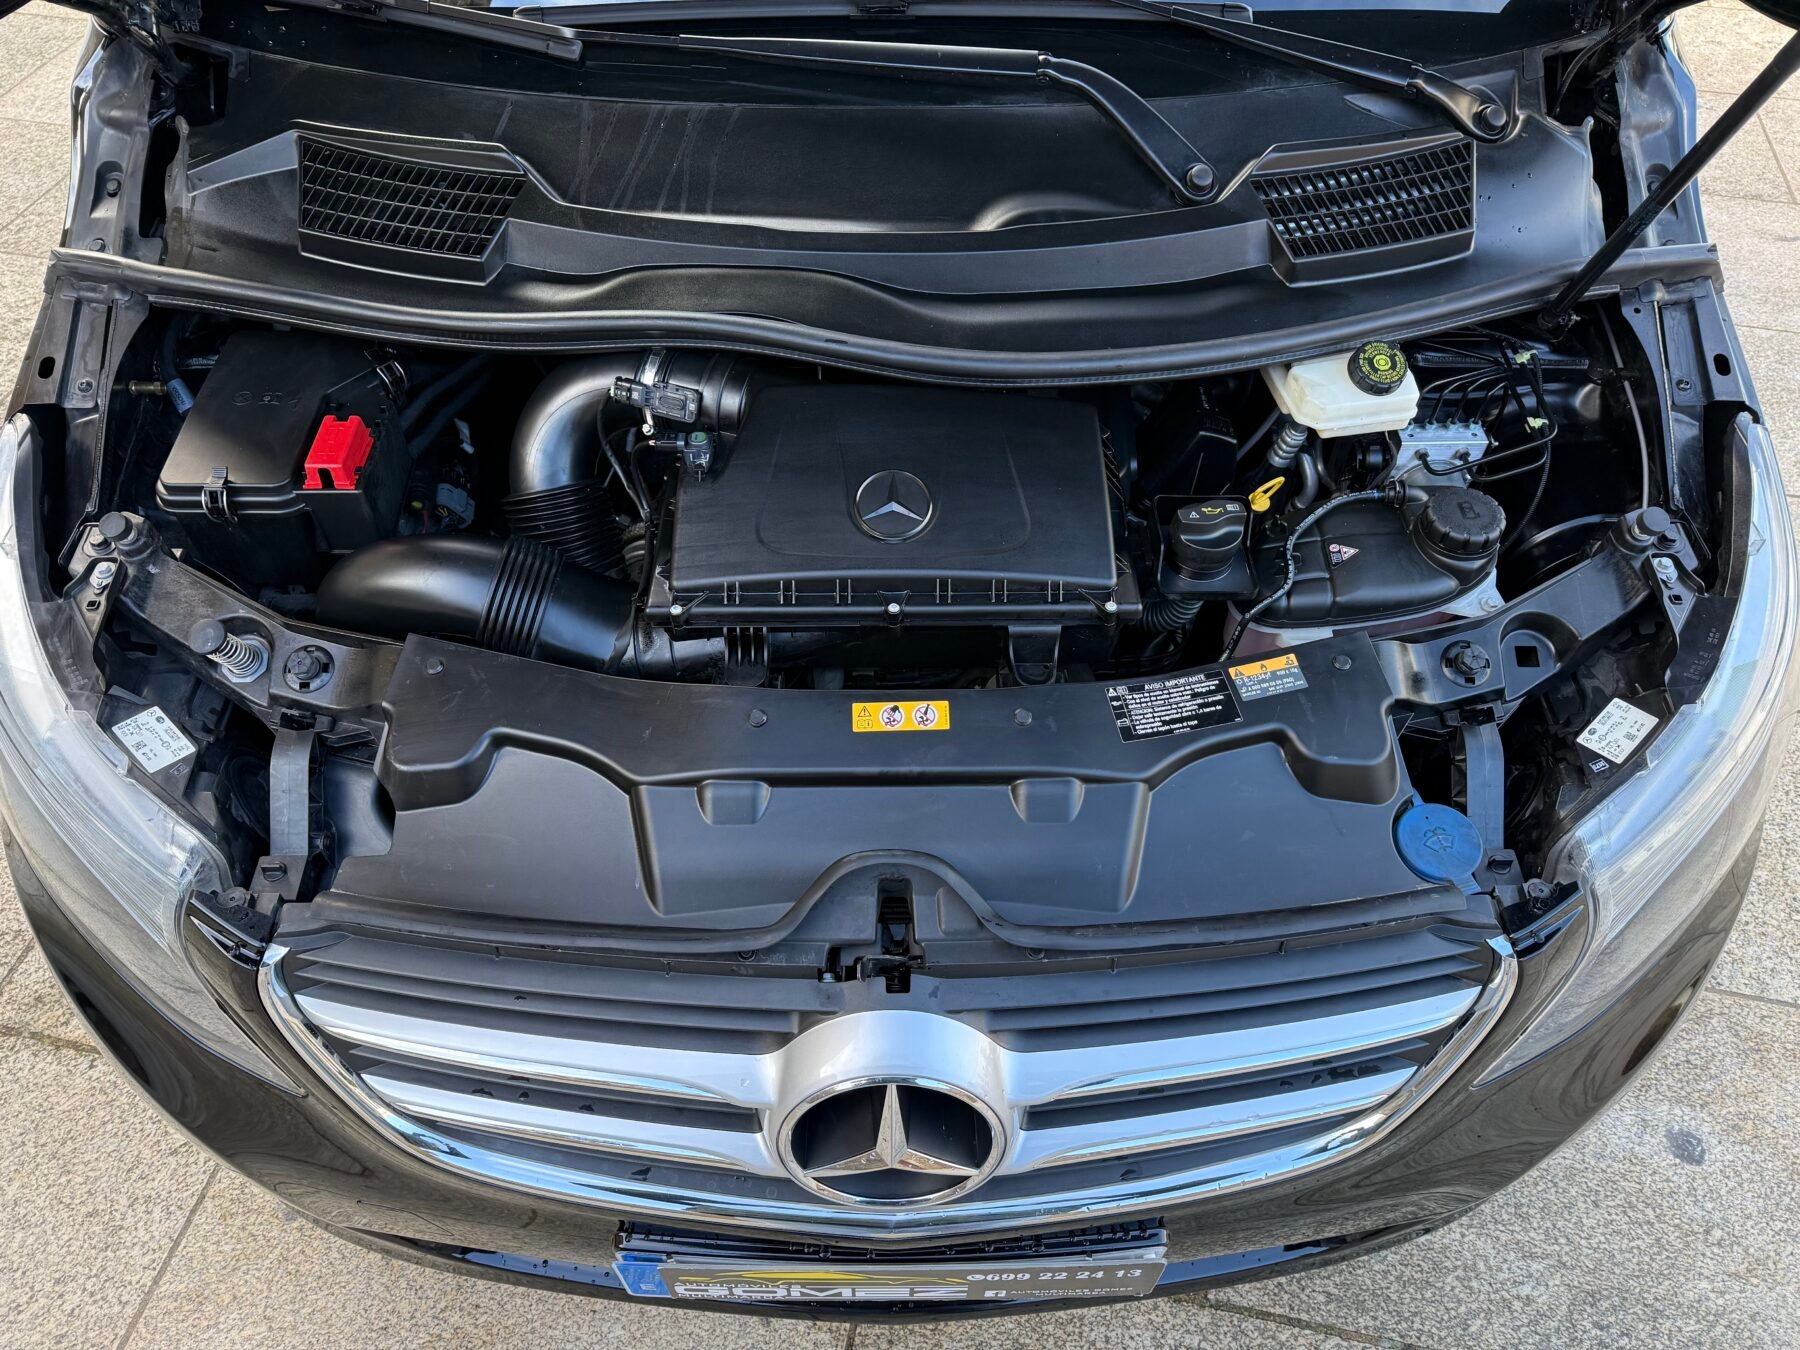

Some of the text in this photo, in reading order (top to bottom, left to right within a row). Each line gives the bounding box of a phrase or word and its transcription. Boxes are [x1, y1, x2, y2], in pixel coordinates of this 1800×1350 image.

[1164, 675, 1206, 686] IMPORTANTE
[986, 1269, 1143, 1281] 699 22 24 13
